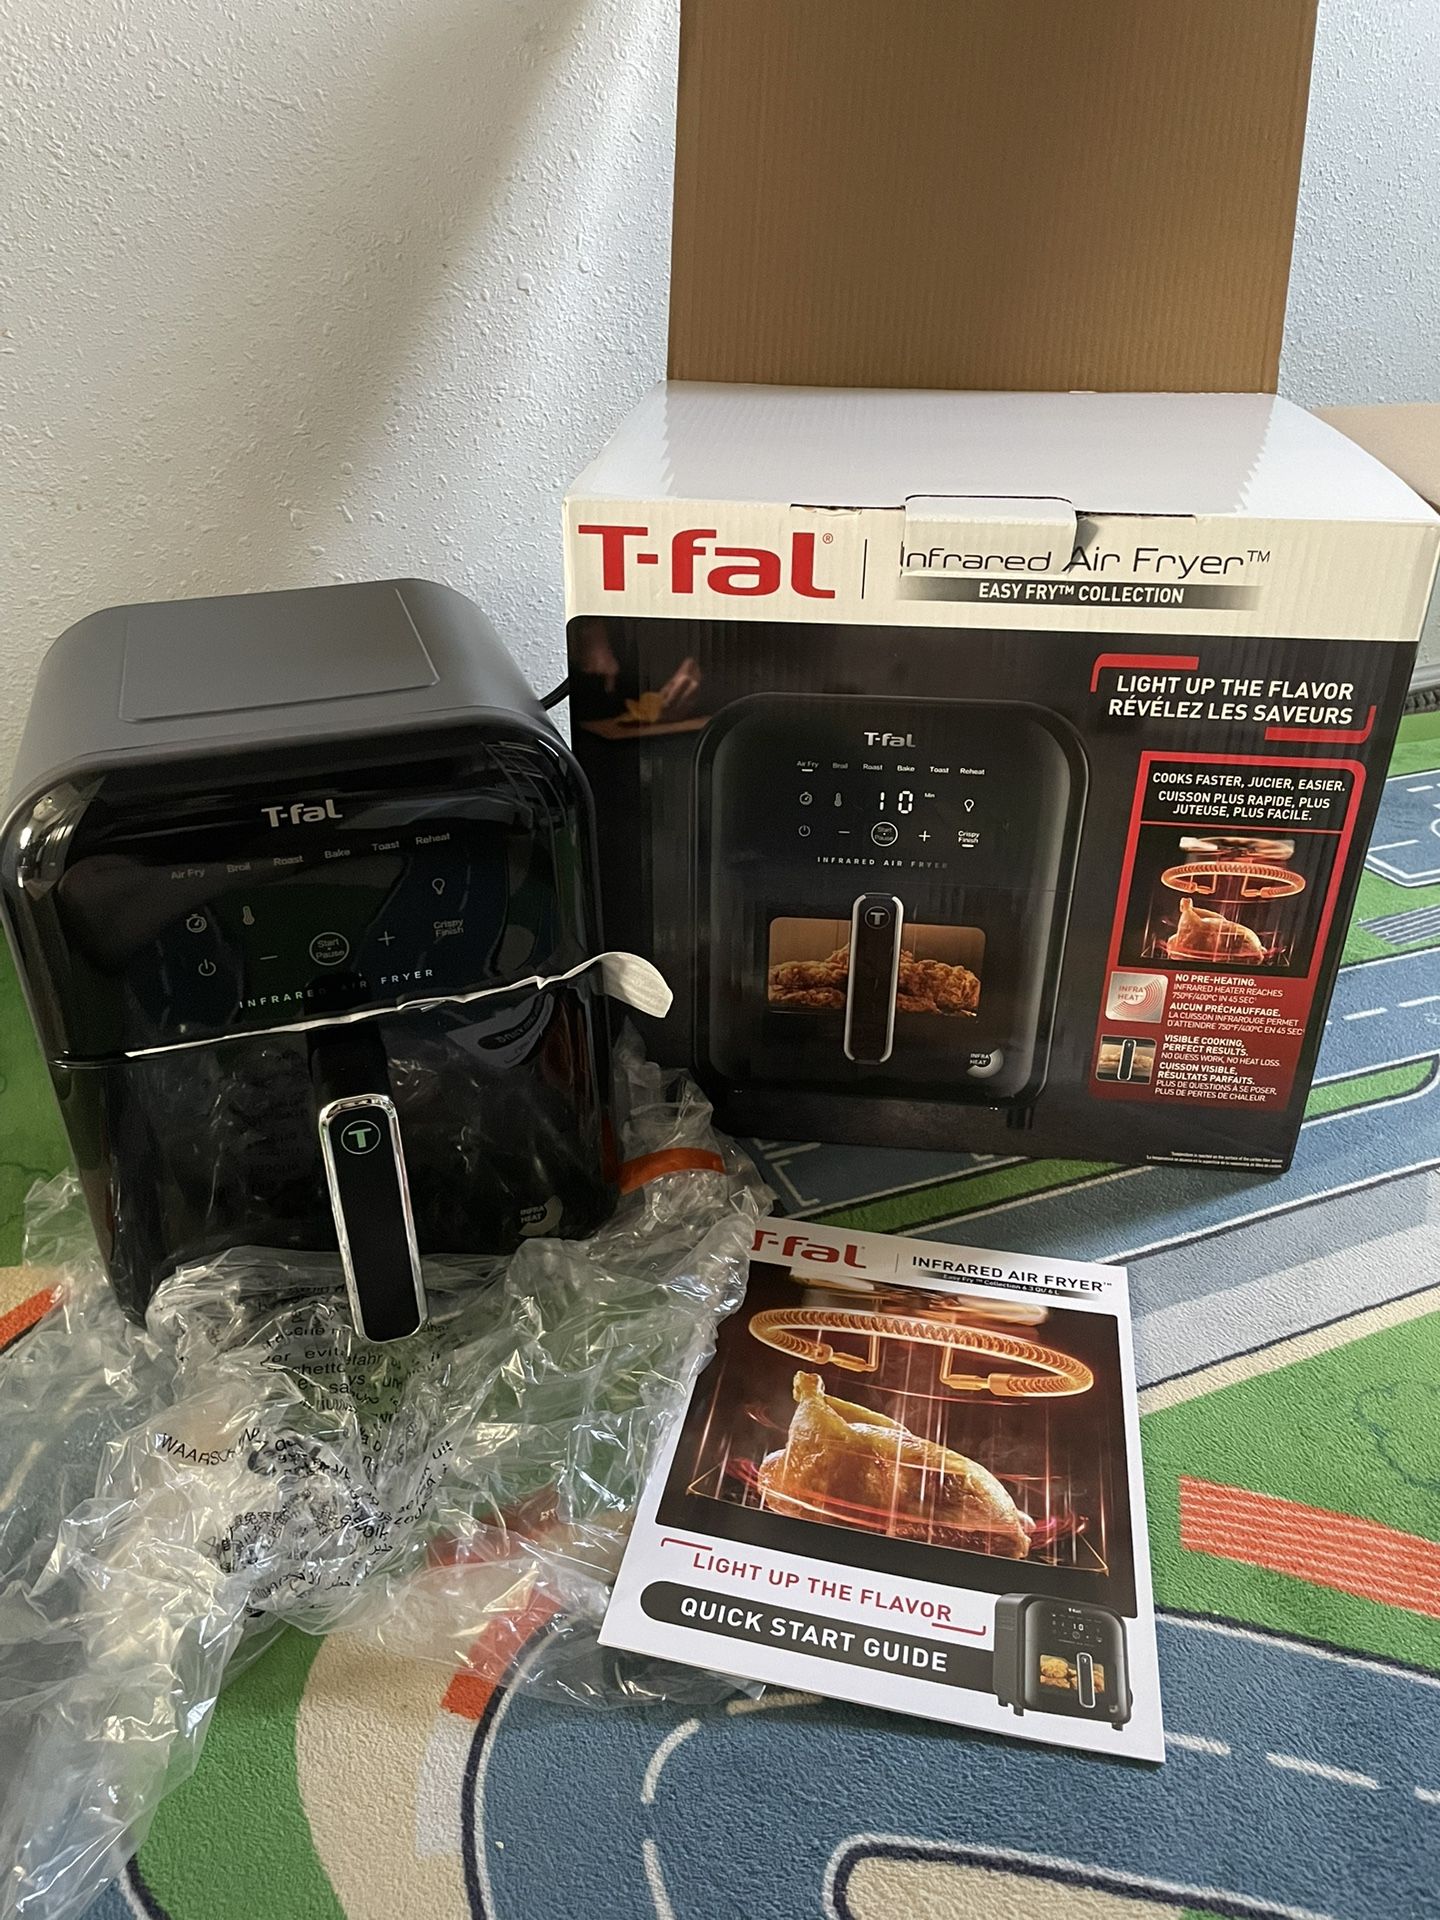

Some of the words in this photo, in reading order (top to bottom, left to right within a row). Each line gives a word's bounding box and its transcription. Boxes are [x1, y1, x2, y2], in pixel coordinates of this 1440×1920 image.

[1062, 546, 1121, 572] Air
[978, 582, 1022, 599] EASY
[1078, 586, 1185, 604] COLLECTION
[1116, 675, 1181, 694] LIGHT
[1185, 677, 1216, 695] UP
[1220, 679, 1263, 697] THE
[1267, 681, 1354, 701] FLAVOR
[1108, 697, 1202, 718] RÉVÉLEZ
[1207, 702, 1248, 720] LES
[1252, 704, 1353, 725] SAVEURS
[863, 731, 917, 748] T-fal
[863, 763, 883, 771] Roast
[929, 766, 950, 774] Toast
[1152, 772, 1193, 785] COOKS
[1195, 774, 1245, 787] FASTER,
[1247, 777, 1295, 791] JUCIER,
[1298, 779, 1345, 792] EASIER.
[1158, 790, 1211, 804] CUISSON
[1213, 793, 1244, 805] PLUS
[1246, 795, 1295, 809] RAPIDE,
[1298, 797, 1330, 809] PLUS
[261, 799, 343, 827] T-fal
[1172, 805, 1230, 819] JUTEUSE,
[1232, 807, 1265, 819] PLUS
[1266, 809, 1313, 822] FACILE.
[415, 832, 451, 846] Reheat
[957, 830, 981, 839] Crispy
[371, 840, 400, 852] Toast
[273, 855, 304, 867] Roast
[324, 849, 351, 859] Bake
[226, 862, 252, 873] Broil
[817, 856, 875, 866] INFRARED
[883, 859, 904, 867] AIR
[170, 870, 186, 880] Air
[187, 867, 206, 879] Fry
[433, 919, 464, 930] Crispy
[317, 938, 340, 949] Start
[315, 950, 345, 960] Pause
[380, 969, 434, 985] FRYER
[1175, 974, 1189, 982] NO
[1190, 975, 1257, 987] PRE-HEATING.
[1118, 985, 1144, 993] INFRA
[1173, 983, 1214, 993] INFRARED
[1214, 986, 1245, 995] HEATER
[1245, 988, 1284, 998] REACHES
[1169, 1002, 1204, 1012] AUCUN
[1204, 1003, 1282, 1018] PRÉCHAUFFAGE.
[1179, 1013, 1215, 1022] CUISSON
[1215, 1015, 1265, 1026] INFRAROUGE
[1265, 1018, 1300, 1027] PERMET
[1264, 1026, 1277, 1034] EN
[1164, 1034, 1201, 1044] VISIBLE
[1200, 1037, 1245, 1048] COOKING,
[1162, 1043, 1204, 1053] PERFECT
[1205, 1046, 1249, 1057] RESULTS.
[1173, 1053, 1200, 1061] GUESS
[1226, 1056, 1239, 1064] NO
[1159, 1061, 1200, 1072] CUISSON
[1200, 1064, 1239, 1076] VISIBLE,
[1157, 1069, 1209, 1081] RÉSULTATS
[1209, 1074, 1256, 1085] PARFAITS.
[1154, 1087, 1177, 1096] PLUS
[1175, 1089, 1187, 1097] DE
[1186, 1089, 1217, 1099] PERTES
[1217, 1091, 1229, 1099] DE
[1177, 1081, 1188, 1089] DE
[1188, 1081, 1234, 1092] QUESTIONS
[1239, 1085, 1250, 1093] SE
[751, 1230, 867, 1269] T-fal
[912, 1256, 1003, 1278] INFRARED
[1007, 1270, 1038, 1284] AIR
[984, 1280, 1021, 1290] Collection
[693, 1553, 763, 1581] LIGHT
[768, 1569, 800, 1588] UP
[807, 1577, 853, 1602] THE
[859, 1589, 952, 1622] FLAVOR
[681, 1597, 765, 1633] QUICK
[770, 1617, 856, 1652] START
[863, 1637, 948, 1673] GUIDE
